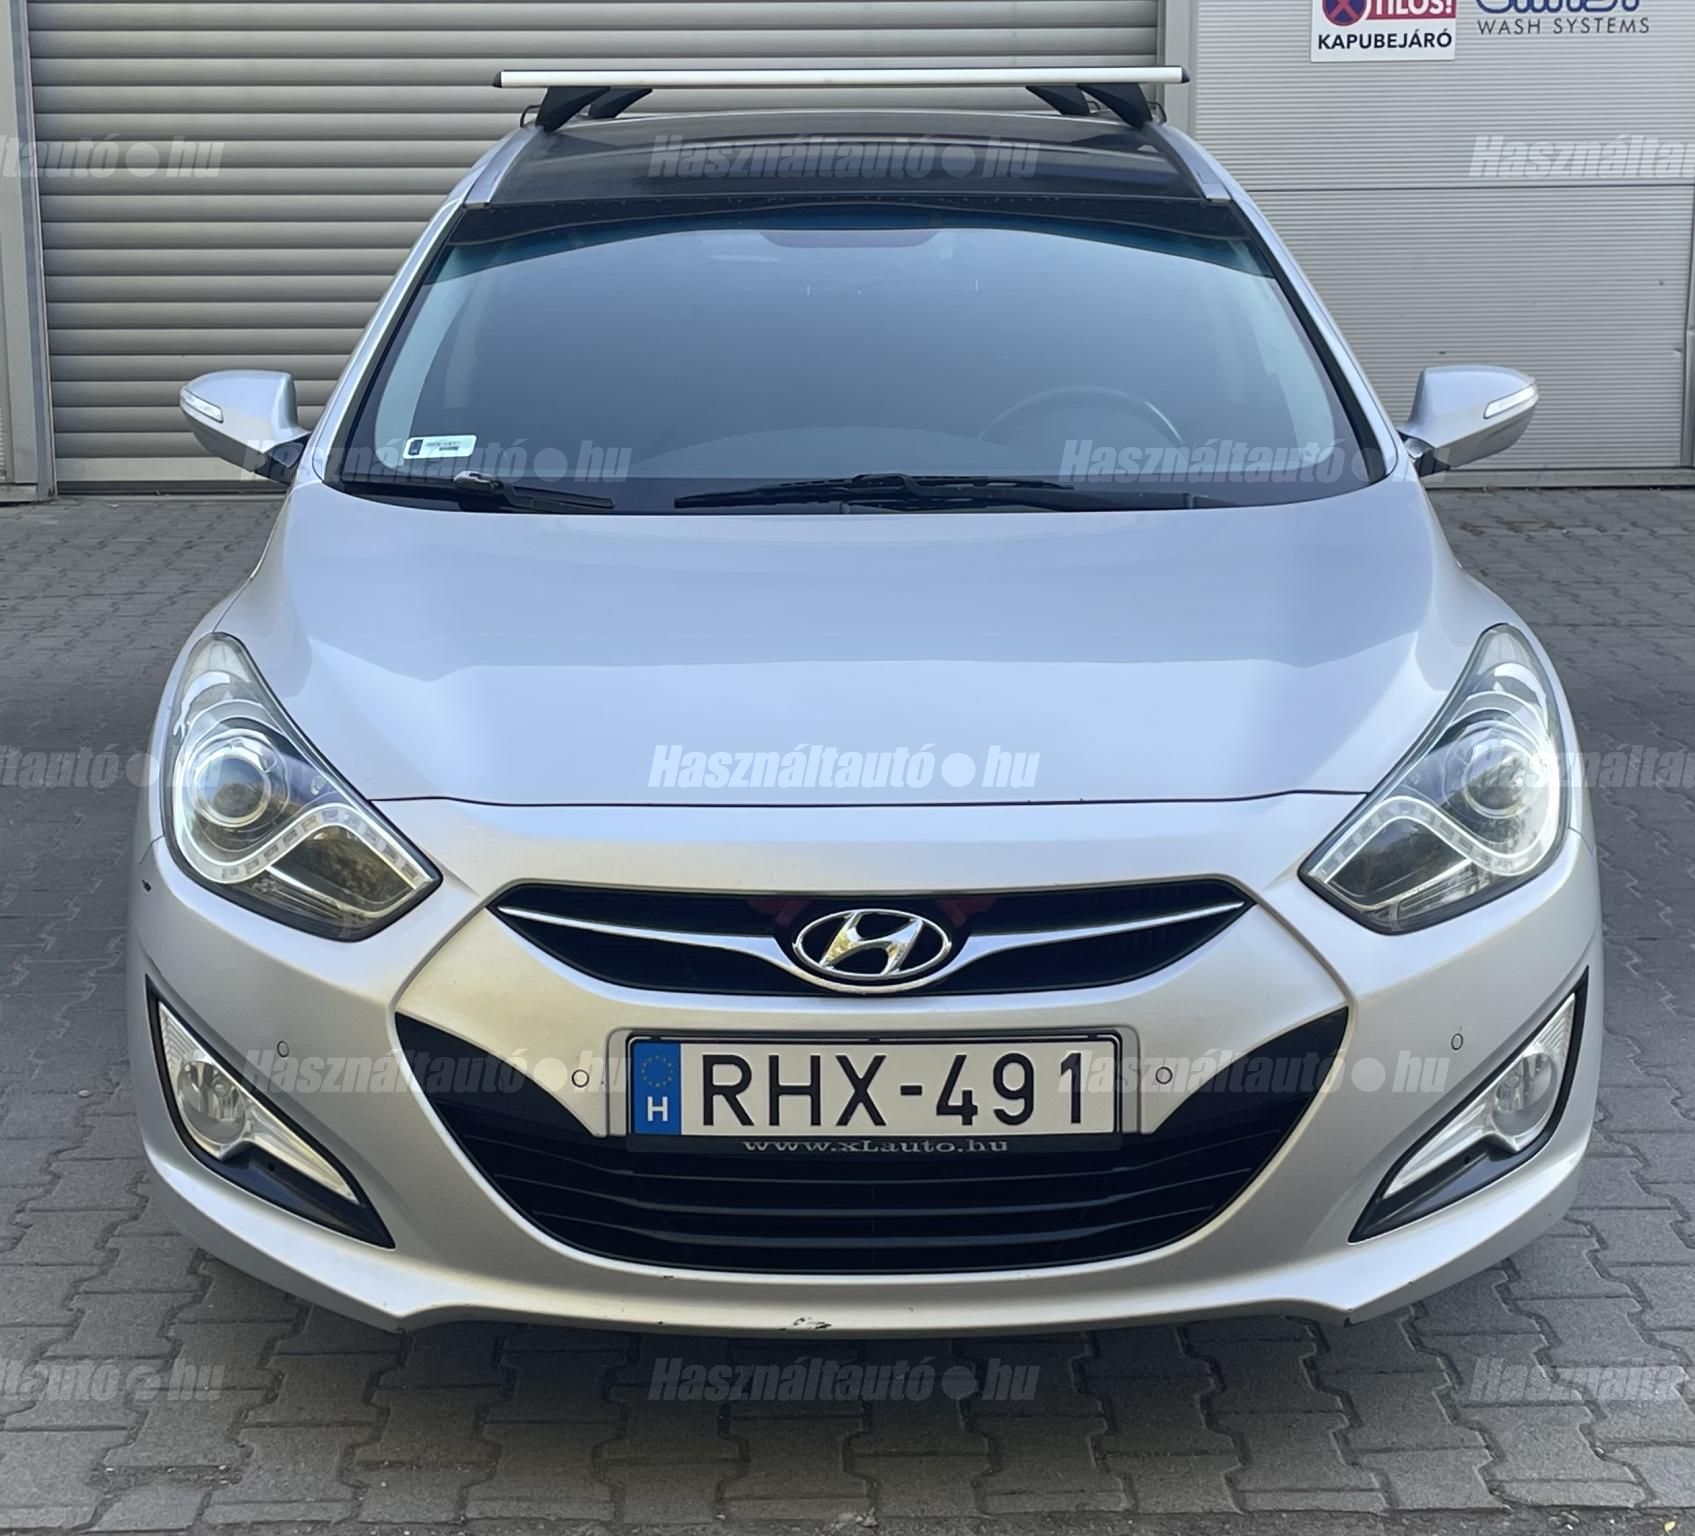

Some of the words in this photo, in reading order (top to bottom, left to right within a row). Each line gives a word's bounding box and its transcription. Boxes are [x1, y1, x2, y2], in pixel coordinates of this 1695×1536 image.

[1477, 18, 1541, 35] WASH
[1553, 17, 1650, 34] SYSTEMS
[1318, 28, 1452, 50] KAPUBEJÁRÓ
[702, 1053, 1083, 1127] RHX-491
[647, 1096, 669, 1122] H
